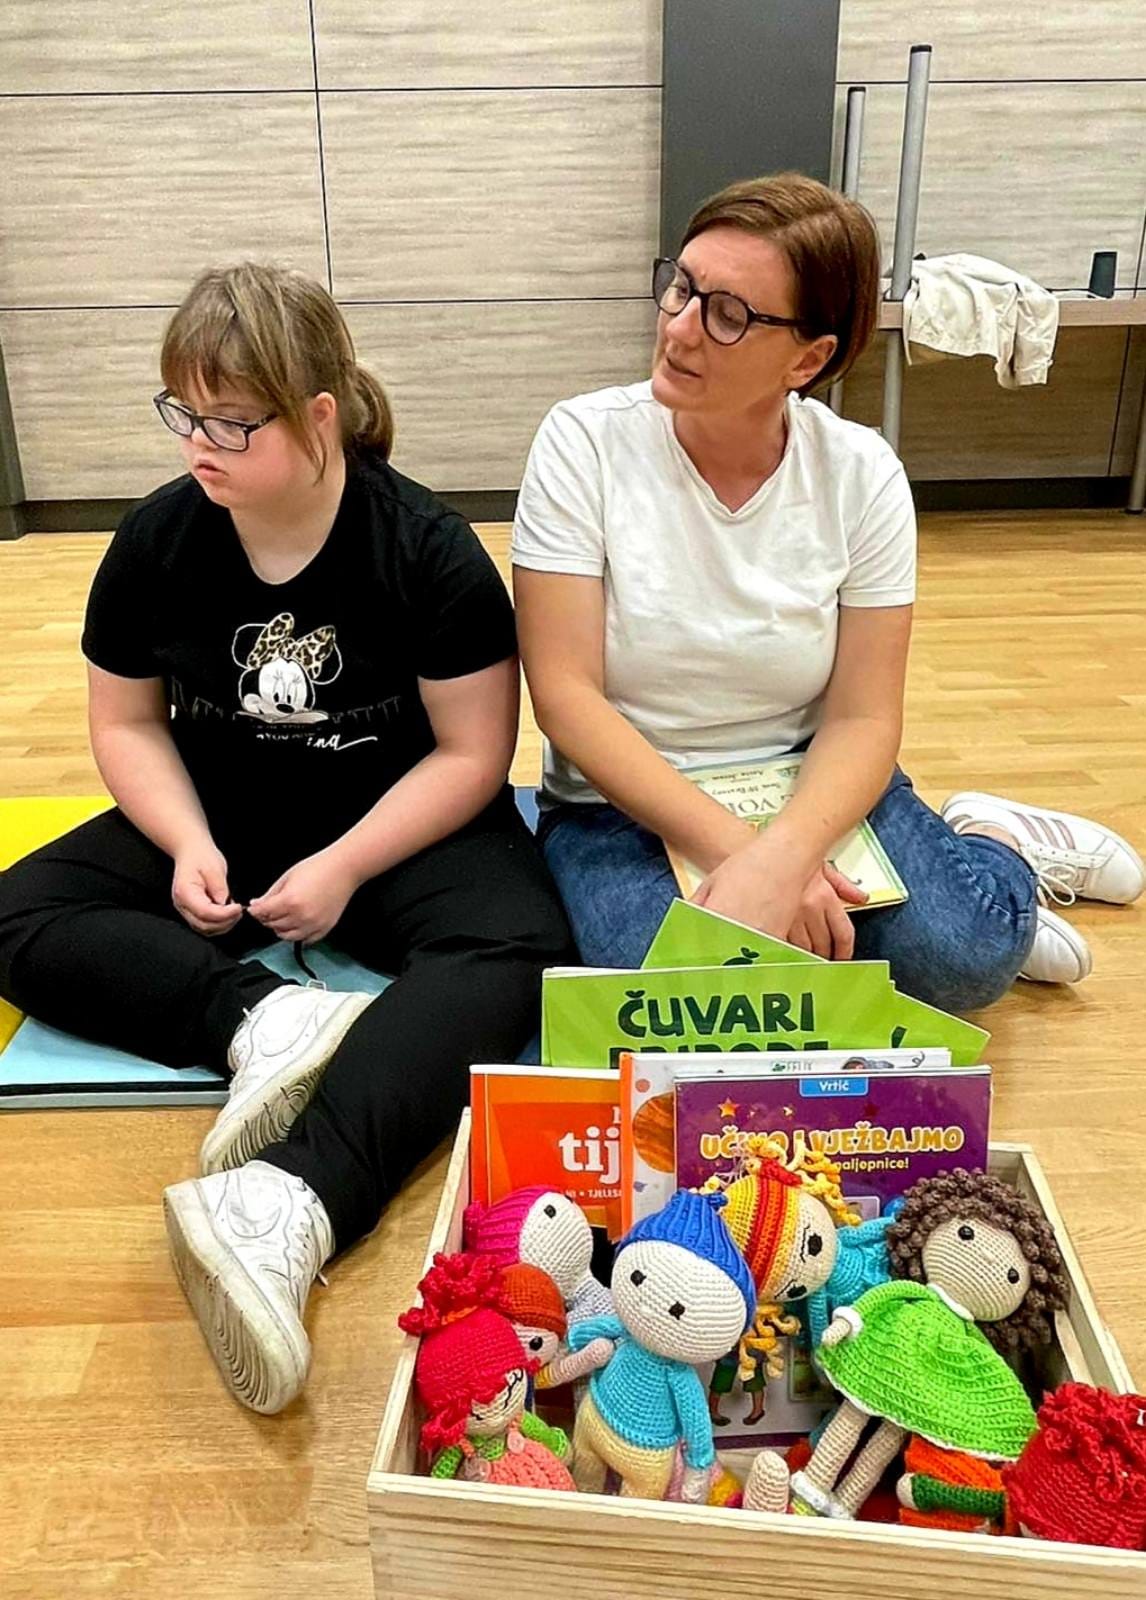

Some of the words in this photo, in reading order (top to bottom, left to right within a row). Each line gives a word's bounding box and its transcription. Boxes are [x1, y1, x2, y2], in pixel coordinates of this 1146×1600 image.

[617, 990, 815, 1038] ČUVARI
[819, 1081, 850, 1092] Vrtić
[809, 1121, 965, 1155] VJEŽBAJMO
